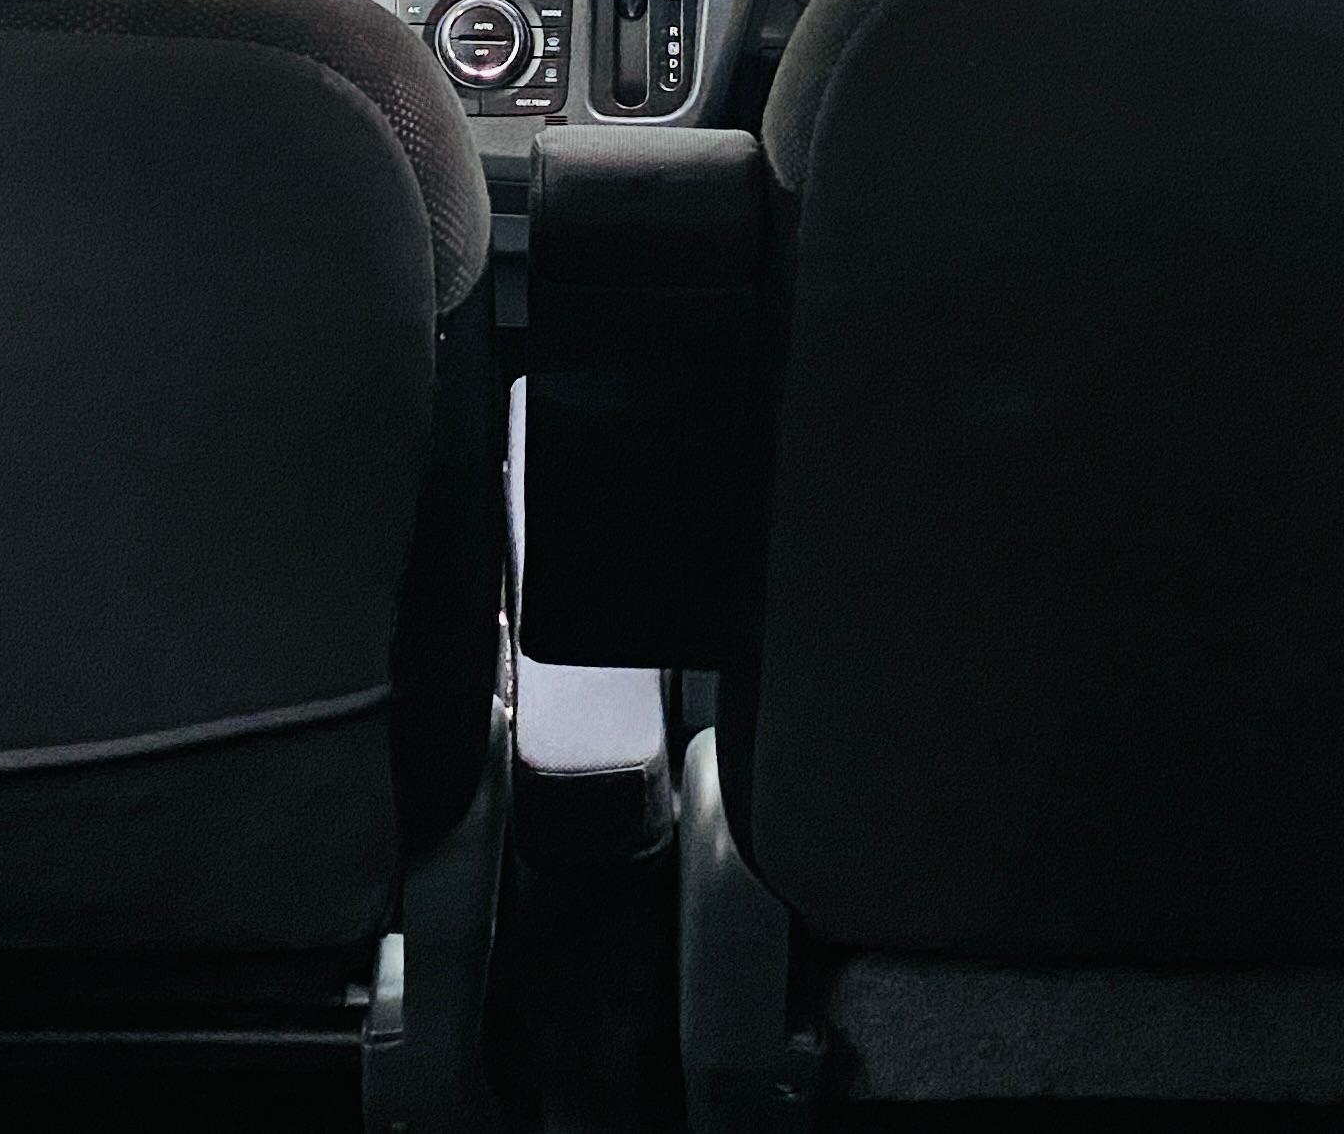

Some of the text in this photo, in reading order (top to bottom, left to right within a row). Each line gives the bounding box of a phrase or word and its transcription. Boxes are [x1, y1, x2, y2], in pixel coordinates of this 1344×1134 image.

[473, 22, 494, 31] AUTO
[669, 26, 679, 37] R
[474, 48, 490, 57] OFF
[669, 58, 679, 69] D
[669, 73, 678, 83] L
